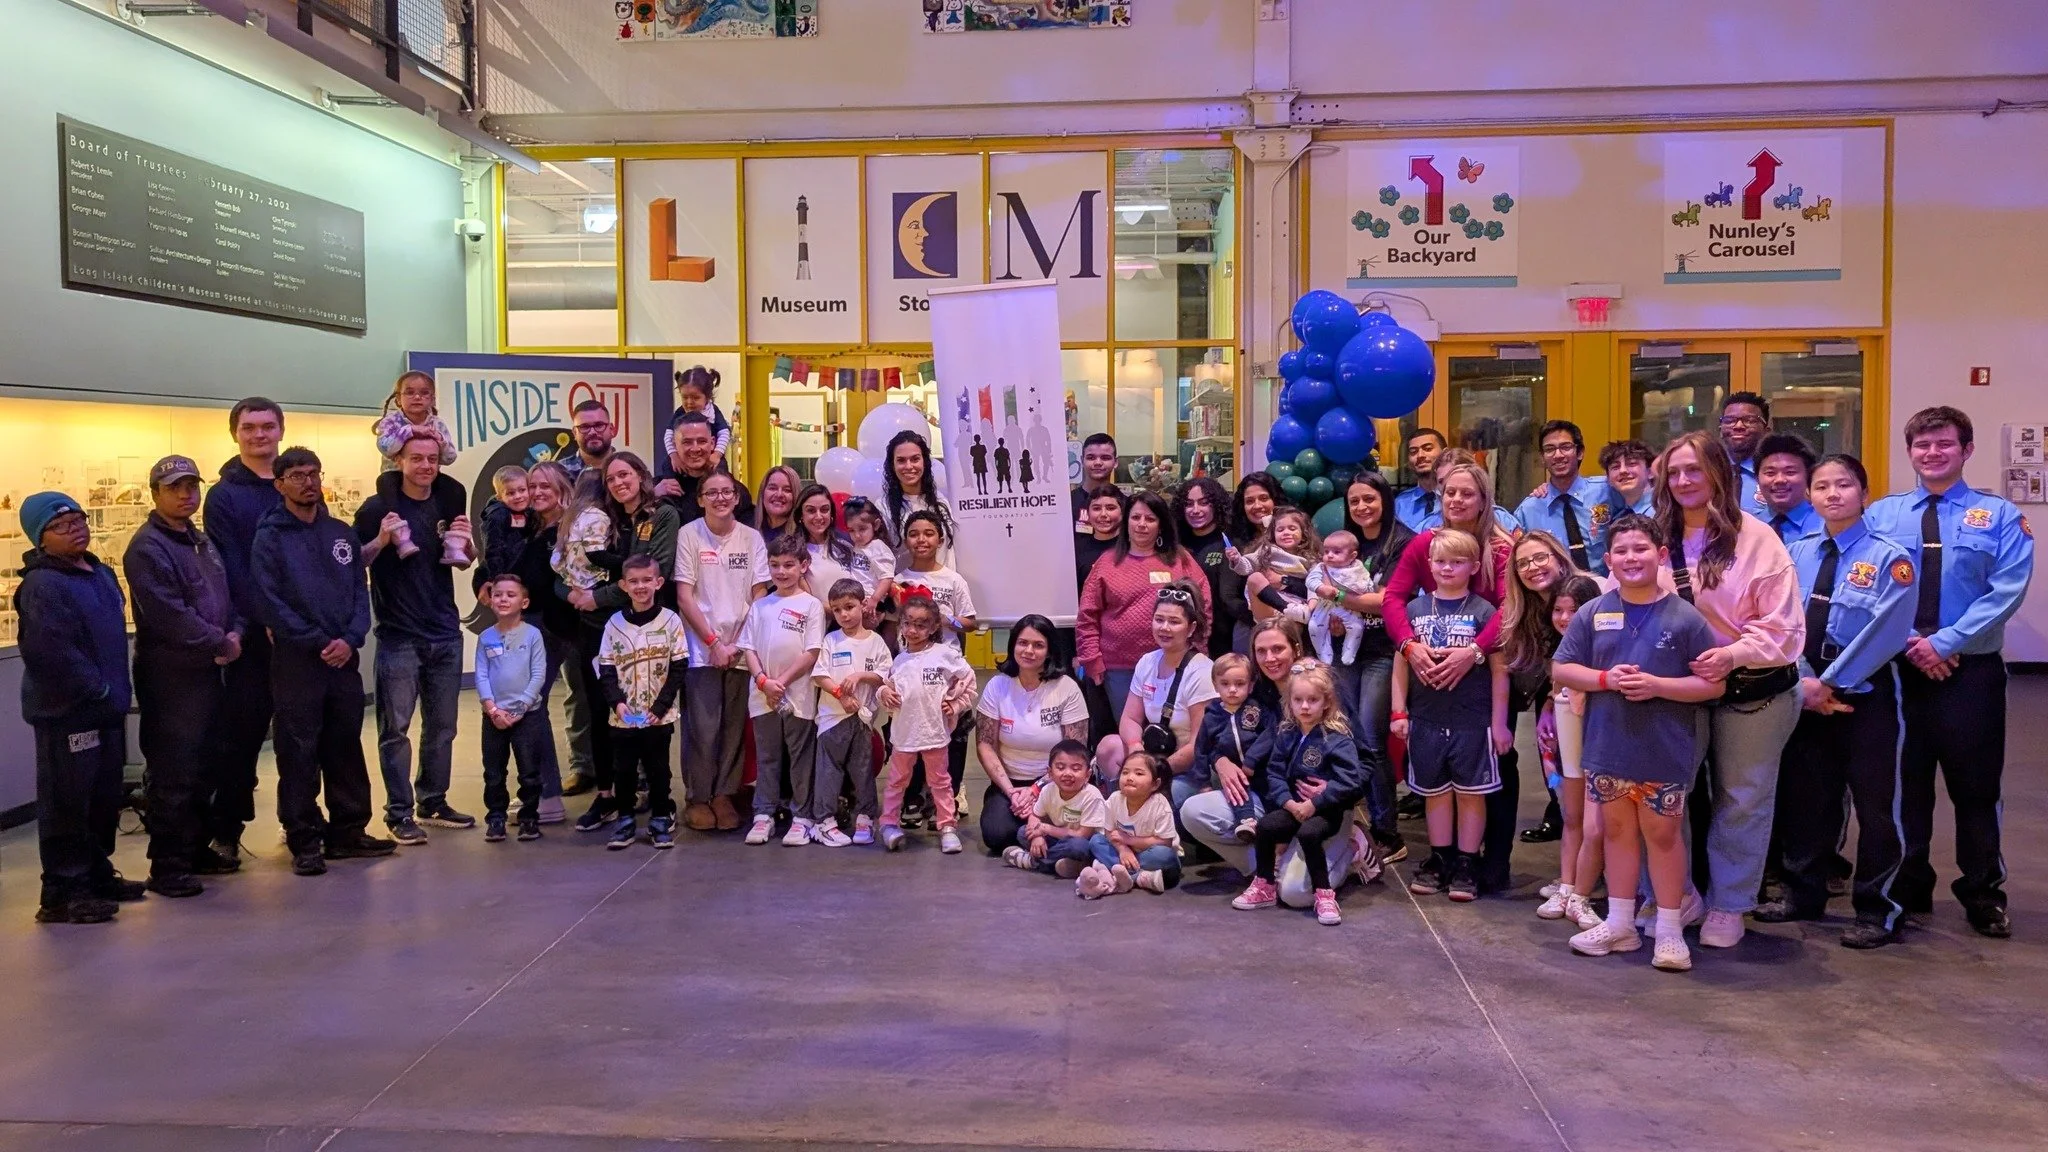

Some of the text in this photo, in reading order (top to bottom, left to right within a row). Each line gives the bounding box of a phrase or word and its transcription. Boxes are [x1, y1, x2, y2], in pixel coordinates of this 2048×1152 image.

[70, 159, 90, 171] Robert
[70, 134, 109, 156] Board
[116, 150, 129, 162] of
[135, 154, 187, 179] Trustees
[249, 191, 264, 204] 27,
[268, 197, 290, 211] 2002
[71, 185, 86, 196] Brian
[996, 190, 1101, 279] M
[1414, 229, 1450, 245] Our
[1709, 221, 1795, 242] Nunley's
[1387, 247, 1476, 267] Backyard
[1708, 240, 1795, 257] Carousel
[73, 265, 98, 279] Long
[103, 270, 133, 284] Island
[137, 276, 184, 293] Children's
[188, 286, 220, 299] Museum
[224, 293, 251, 304] opened
[761, 296, 848, 313] Museum
[898, 295, 930, 312] Sto
[454, 380, 639, 452] INSIDE OUT
[959, 494, 1056, 511] RESILIENT HOPE
[728, 558, 748, 566] HOPE
[923, 672, 943, 681] HOPE
[1040, 711, 1061, 723] HOPE
